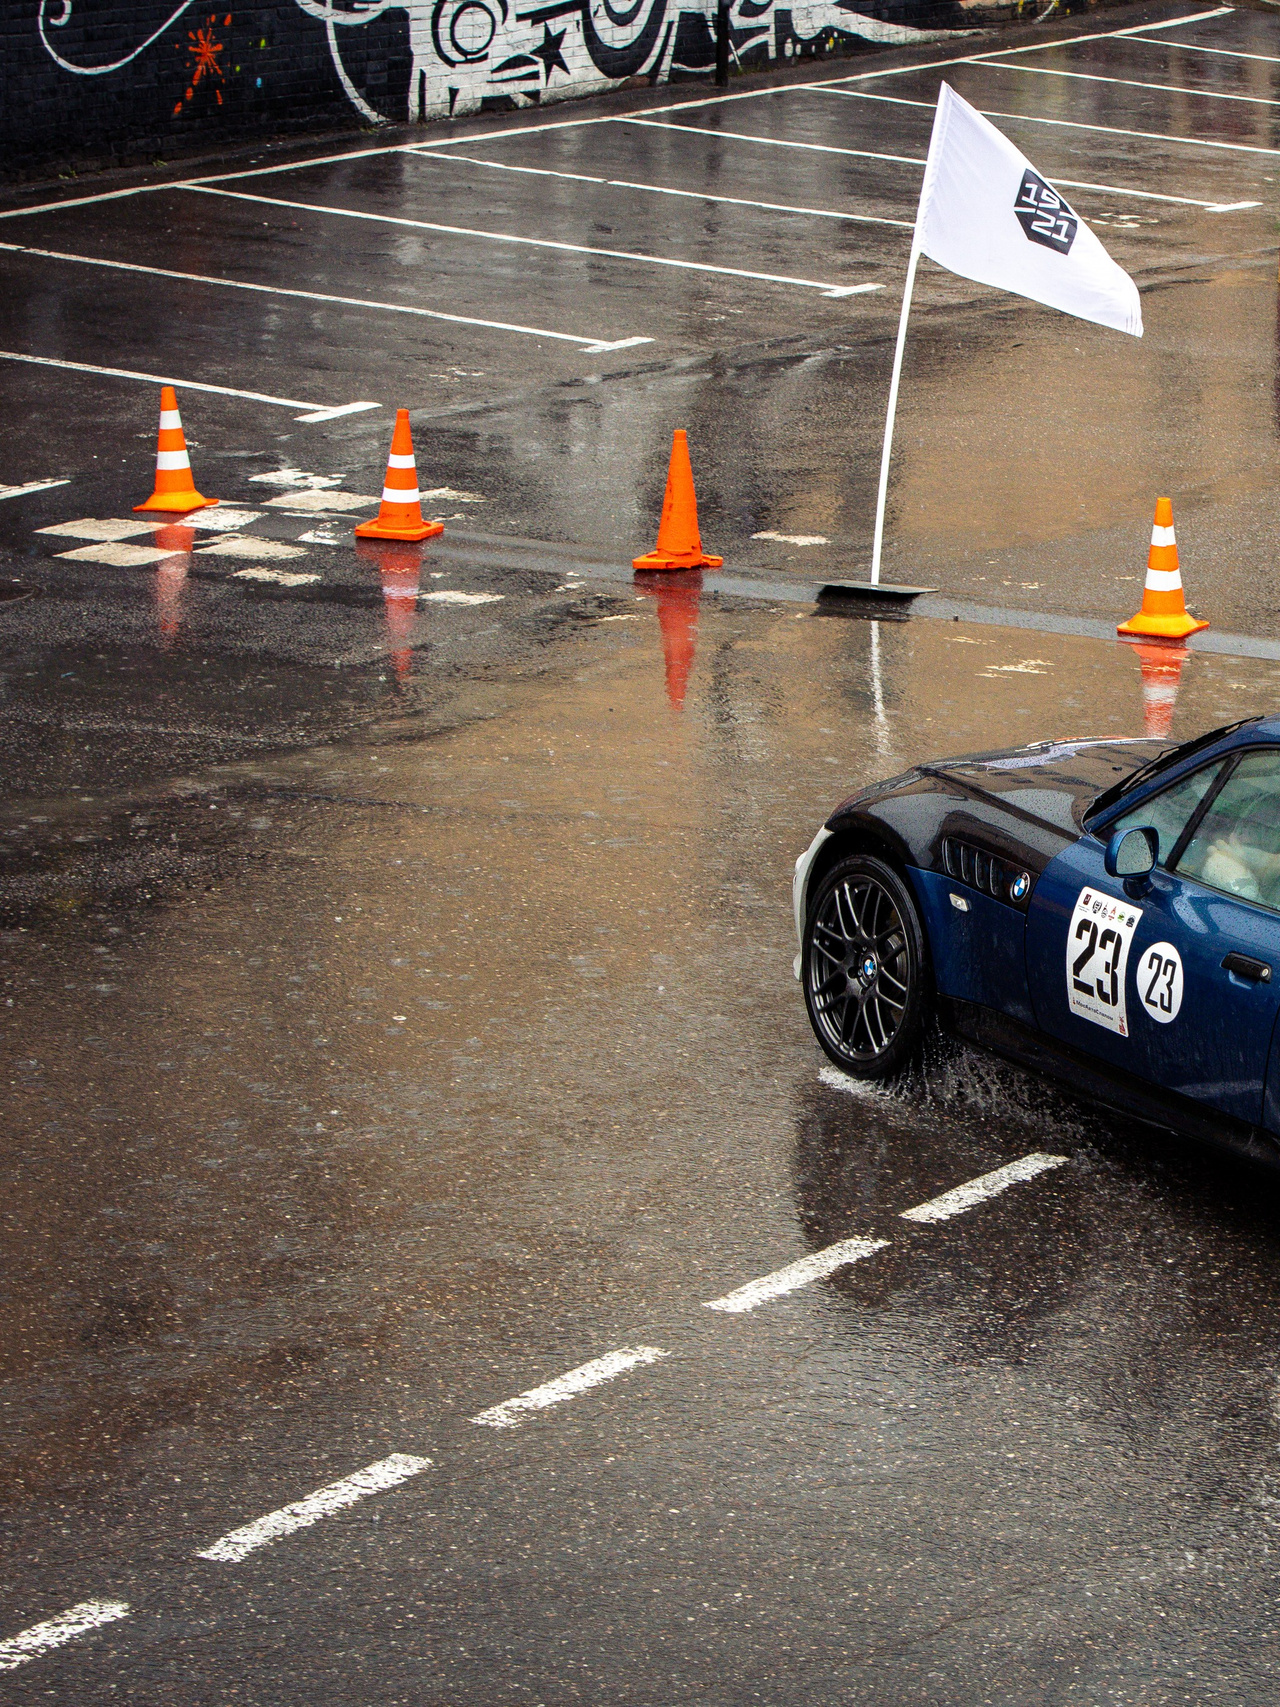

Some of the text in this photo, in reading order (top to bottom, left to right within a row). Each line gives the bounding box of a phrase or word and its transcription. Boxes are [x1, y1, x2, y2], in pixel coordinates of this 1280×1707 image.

[1021, 182, 1060, 210] 19
[1030, 208, 1070, 244] 21
[1072, 918, 1123, 1008] 23
[1144, 951, 1177, 1014] 23
